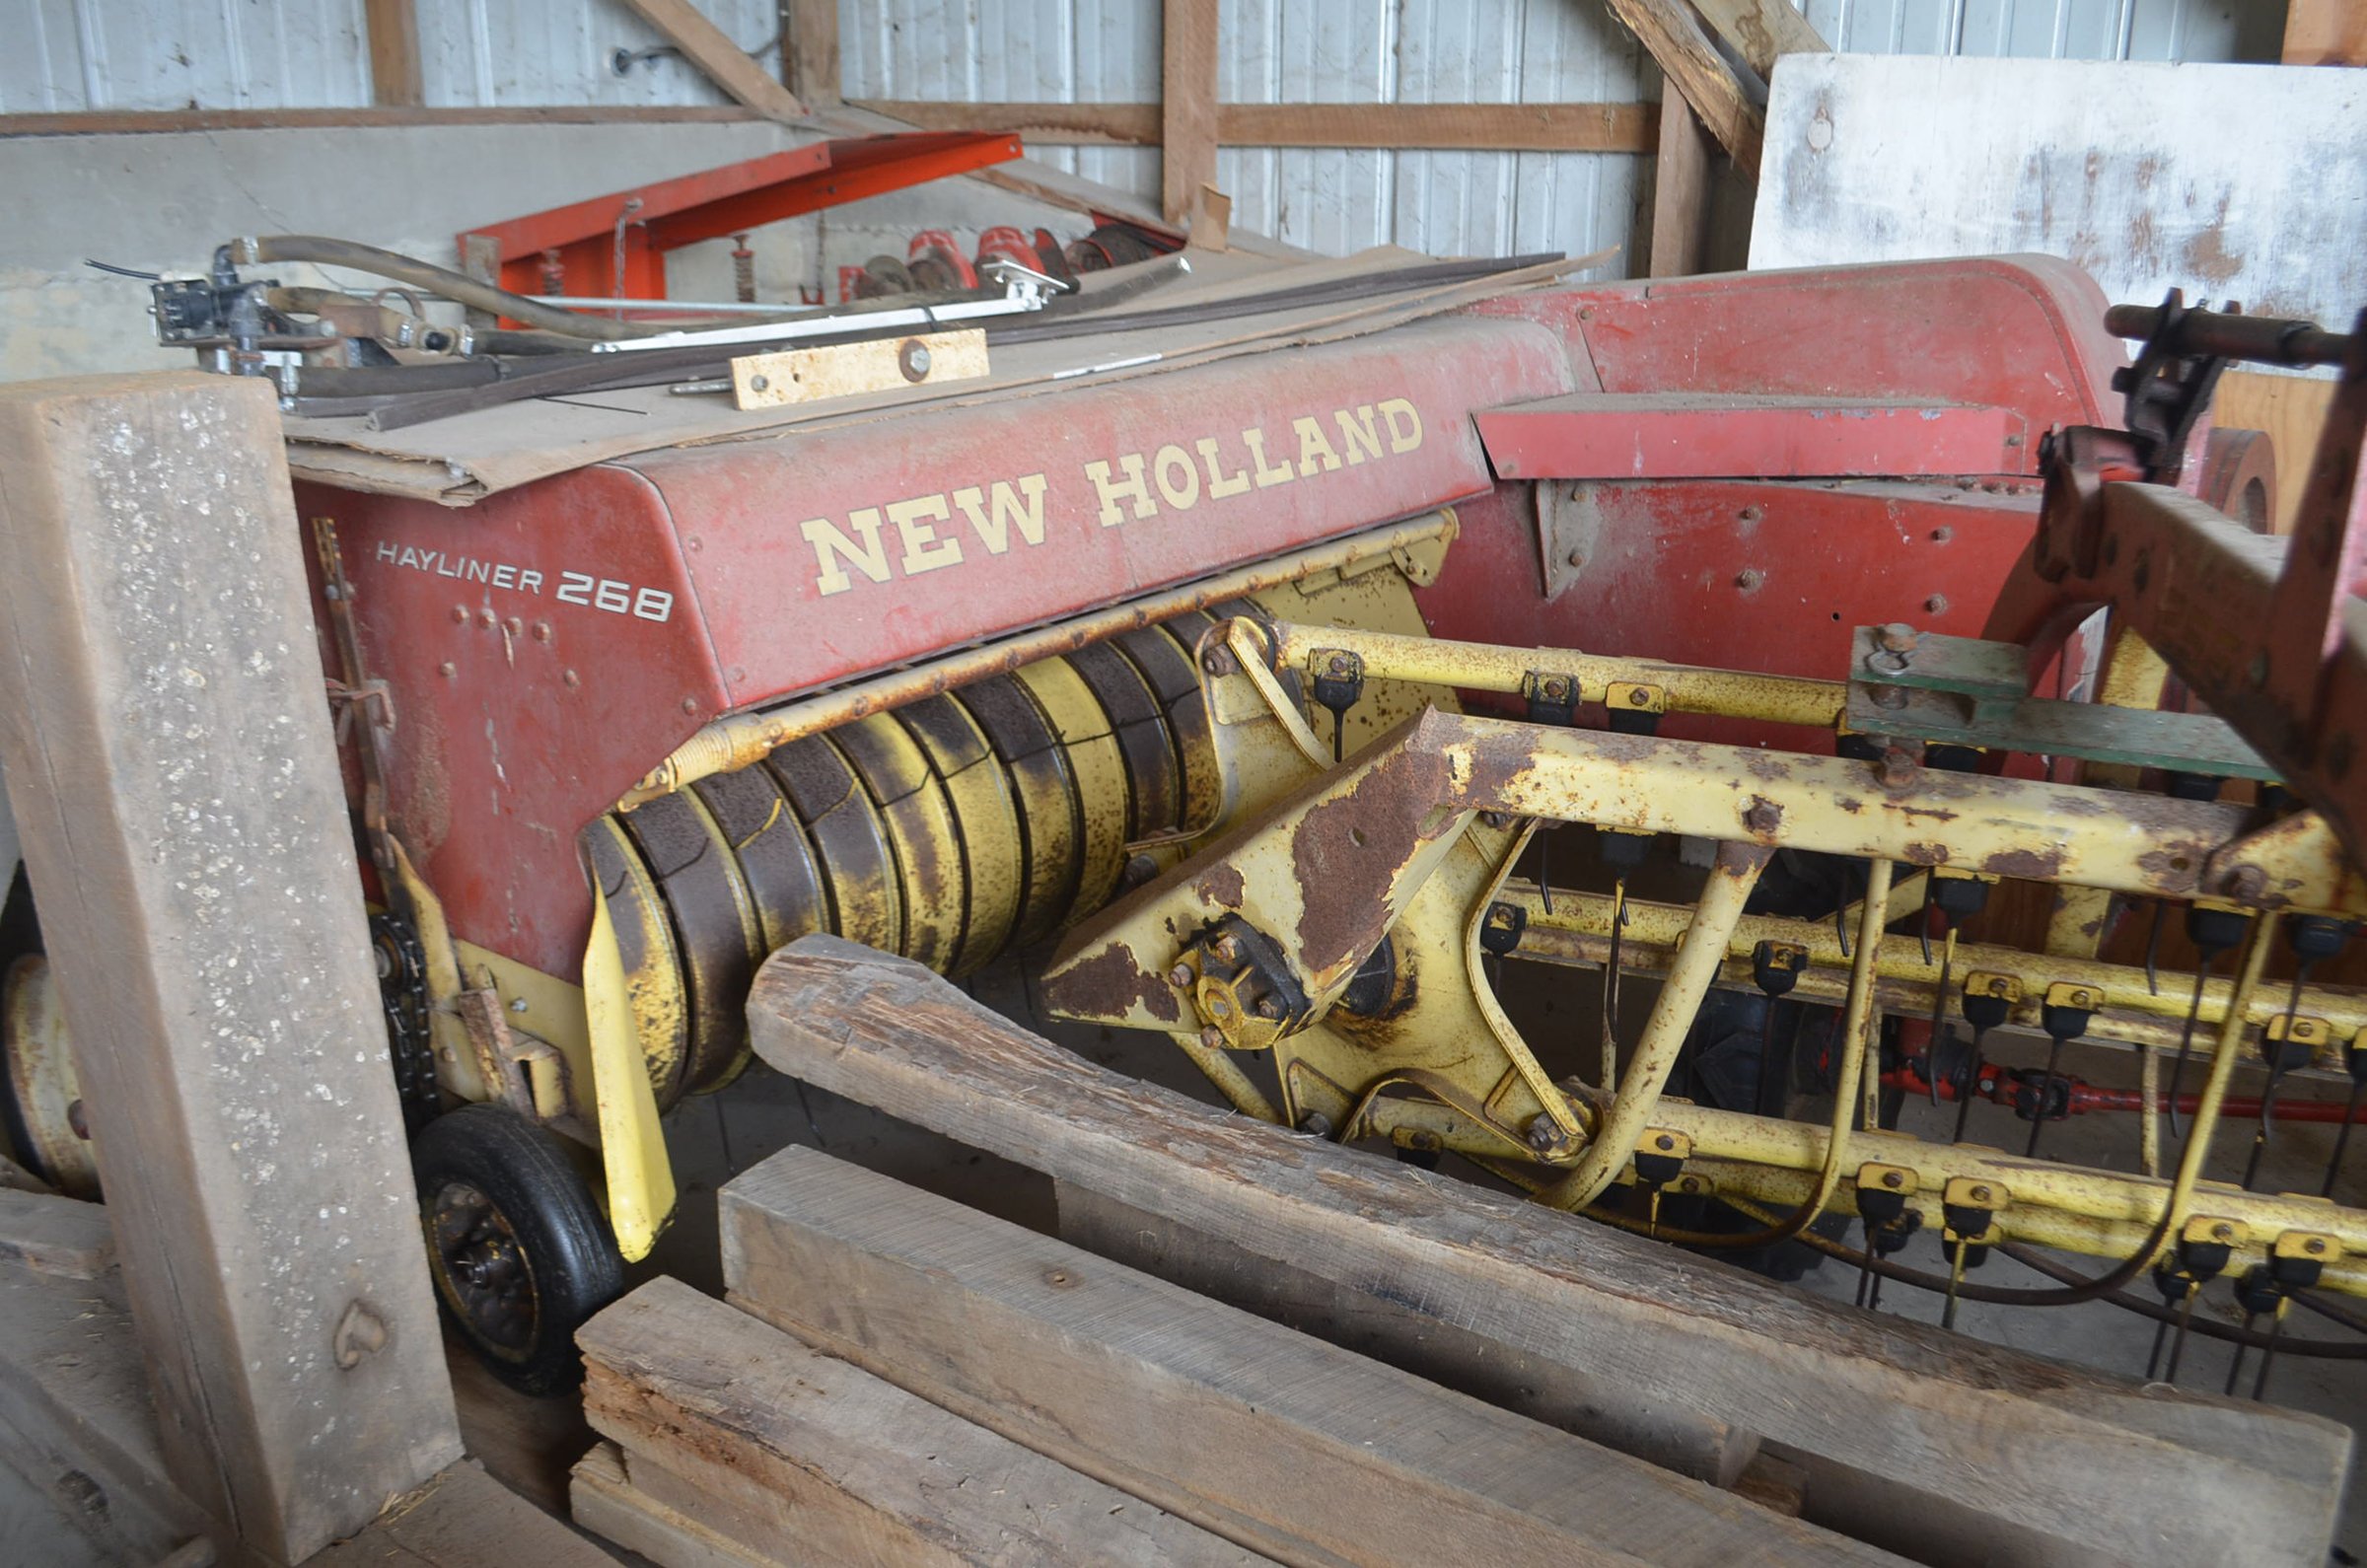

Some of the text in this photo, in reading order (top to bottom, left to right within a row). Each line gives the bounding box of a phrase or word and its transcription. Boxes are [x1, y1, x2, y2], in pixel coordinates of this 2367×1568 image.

[801, 397, 1423, 597] NEW HOLLAND
[376, 540, 674, 623] HAYLINER 268
